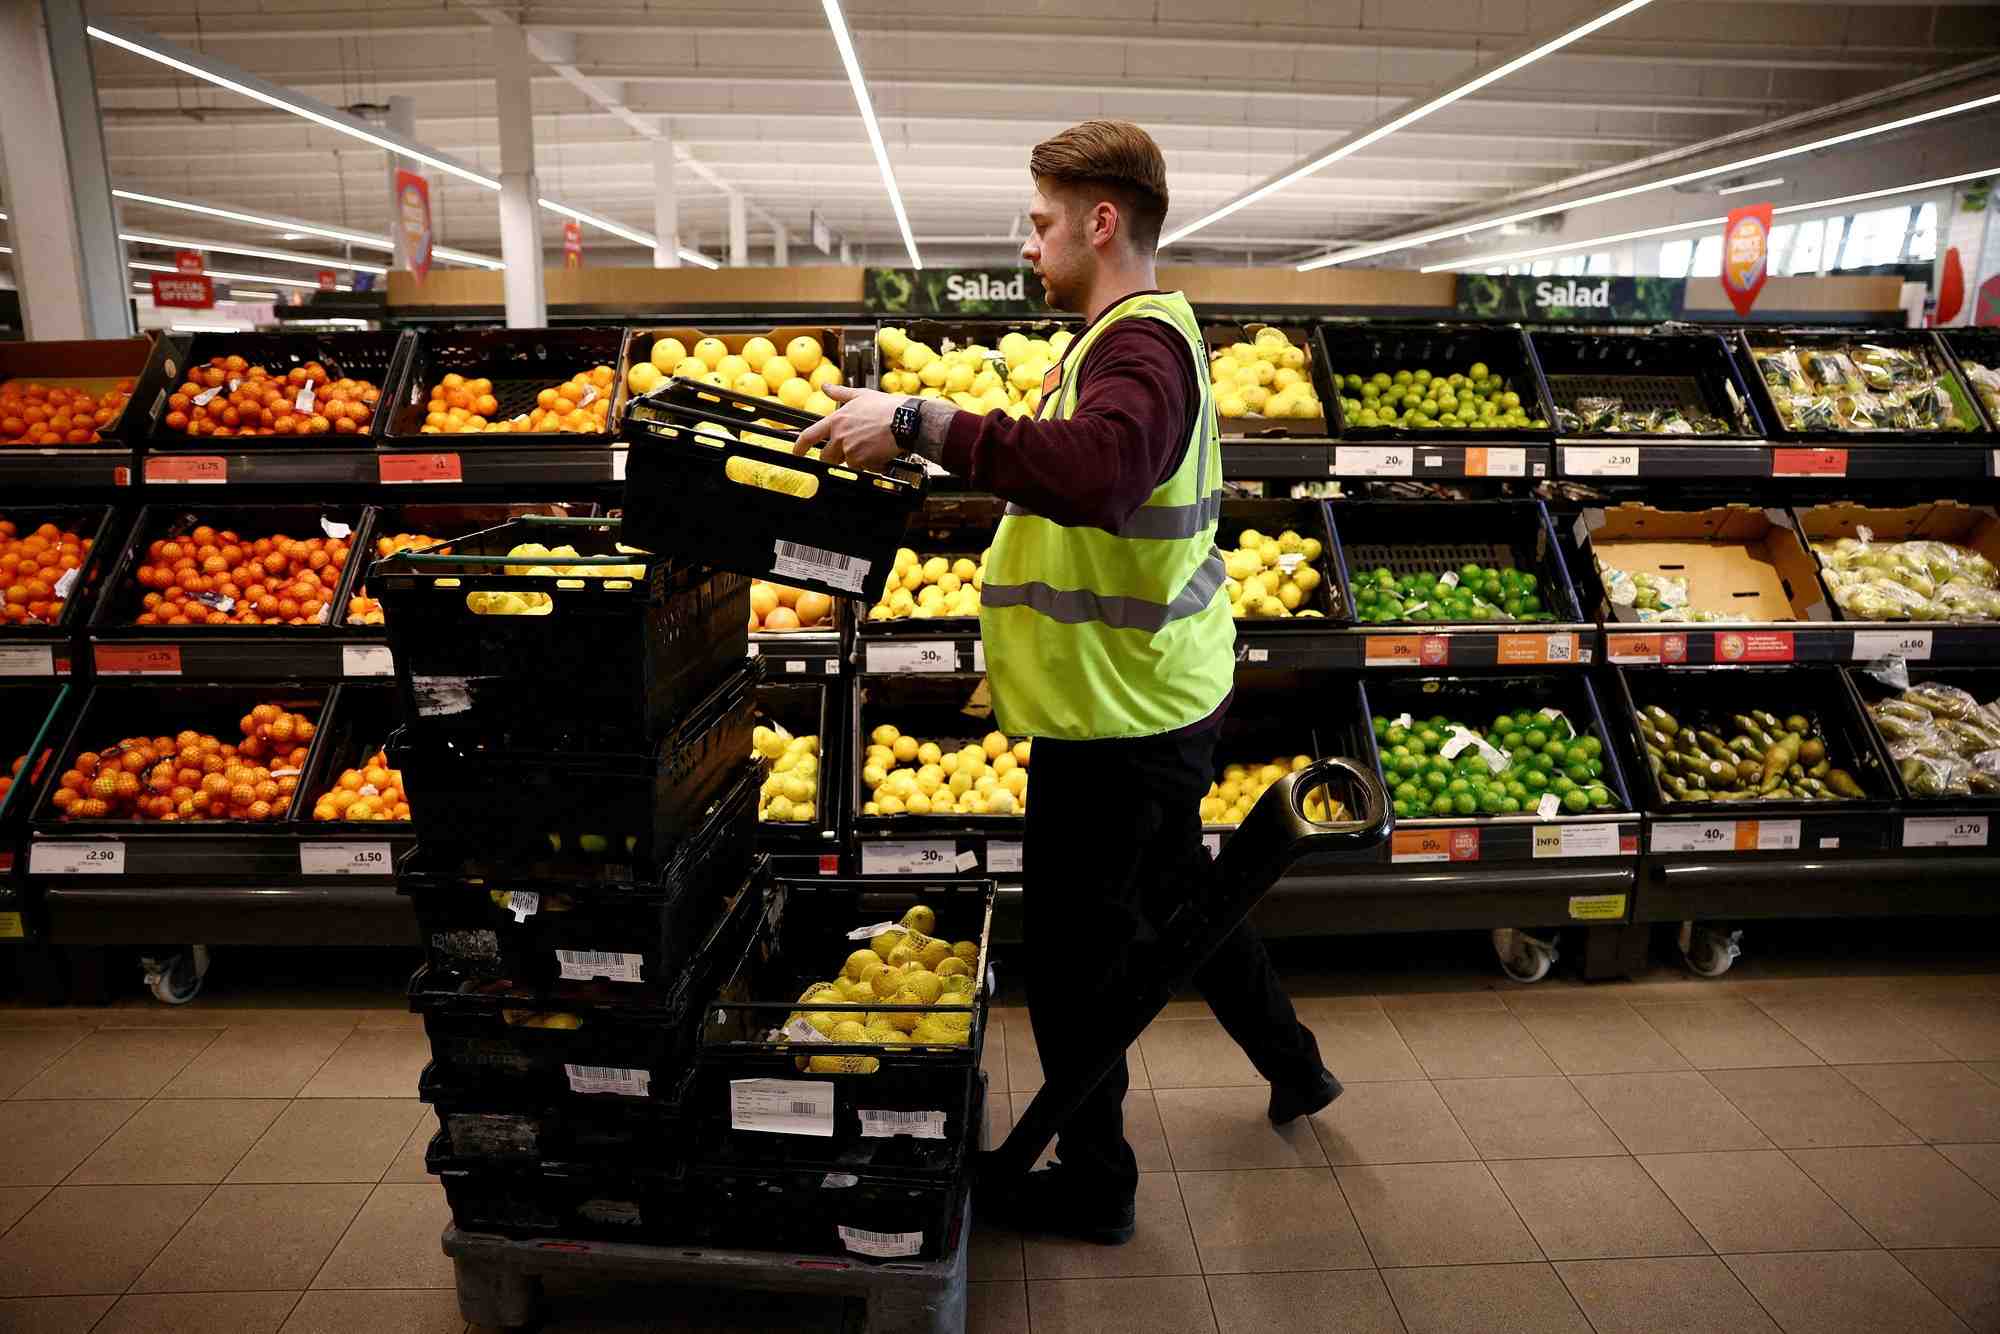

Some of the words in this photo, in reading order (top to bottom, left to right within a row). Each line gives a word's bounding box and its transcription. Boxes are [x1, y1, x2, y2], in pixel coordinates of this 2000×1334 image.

[158, 280, 205, 292] SPECIAL
[946, 273, 1025, 301] Salad
[160, 291, 206, 302] OFFERS
[1536, 280, 1610, 307] Salad
[1385, 455, 1404, 466] 20p
[921, 650, 942, 662] 30p
[1704, 828, 1725, 841] 40p
[1953, 824, 1981, 835] £1.70
[1535, 837, 1560, 848] INFO
[86, 851, 115, 861] £2.90
[354, 852, 382, 863] £1.50
[921, 850, 944, 862] 30p
